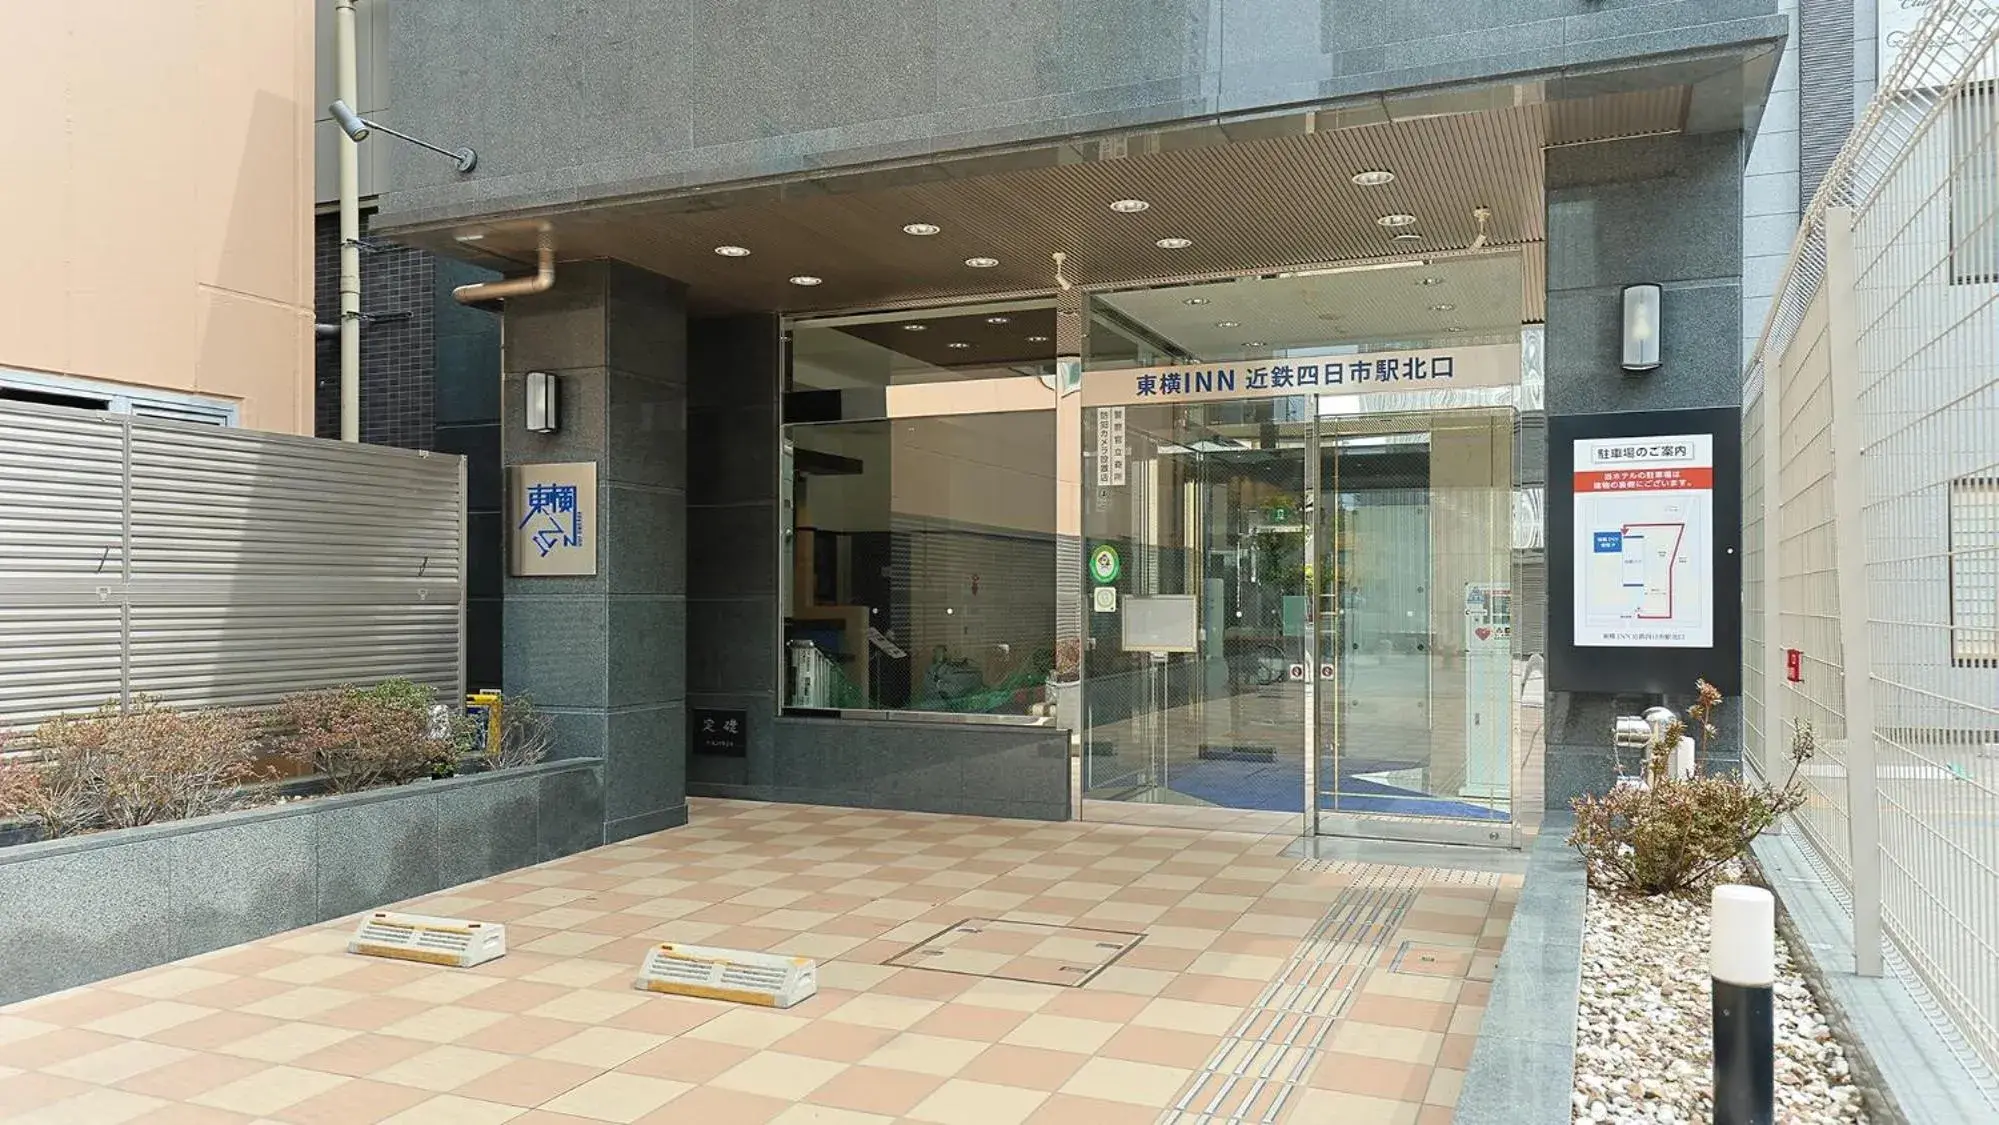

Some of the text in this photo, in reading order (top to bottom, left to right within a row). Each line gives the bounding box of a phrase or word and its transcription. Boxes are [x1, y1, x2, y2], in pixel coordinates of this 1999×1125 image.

[1136, 356, 1454, 397] 東横INN 近鉄四日市駅北口
[1597, 445, 1687, 460] 駐車場のご案内
[1604, 470, 1681, 481] 当ホテルの駐車場は
